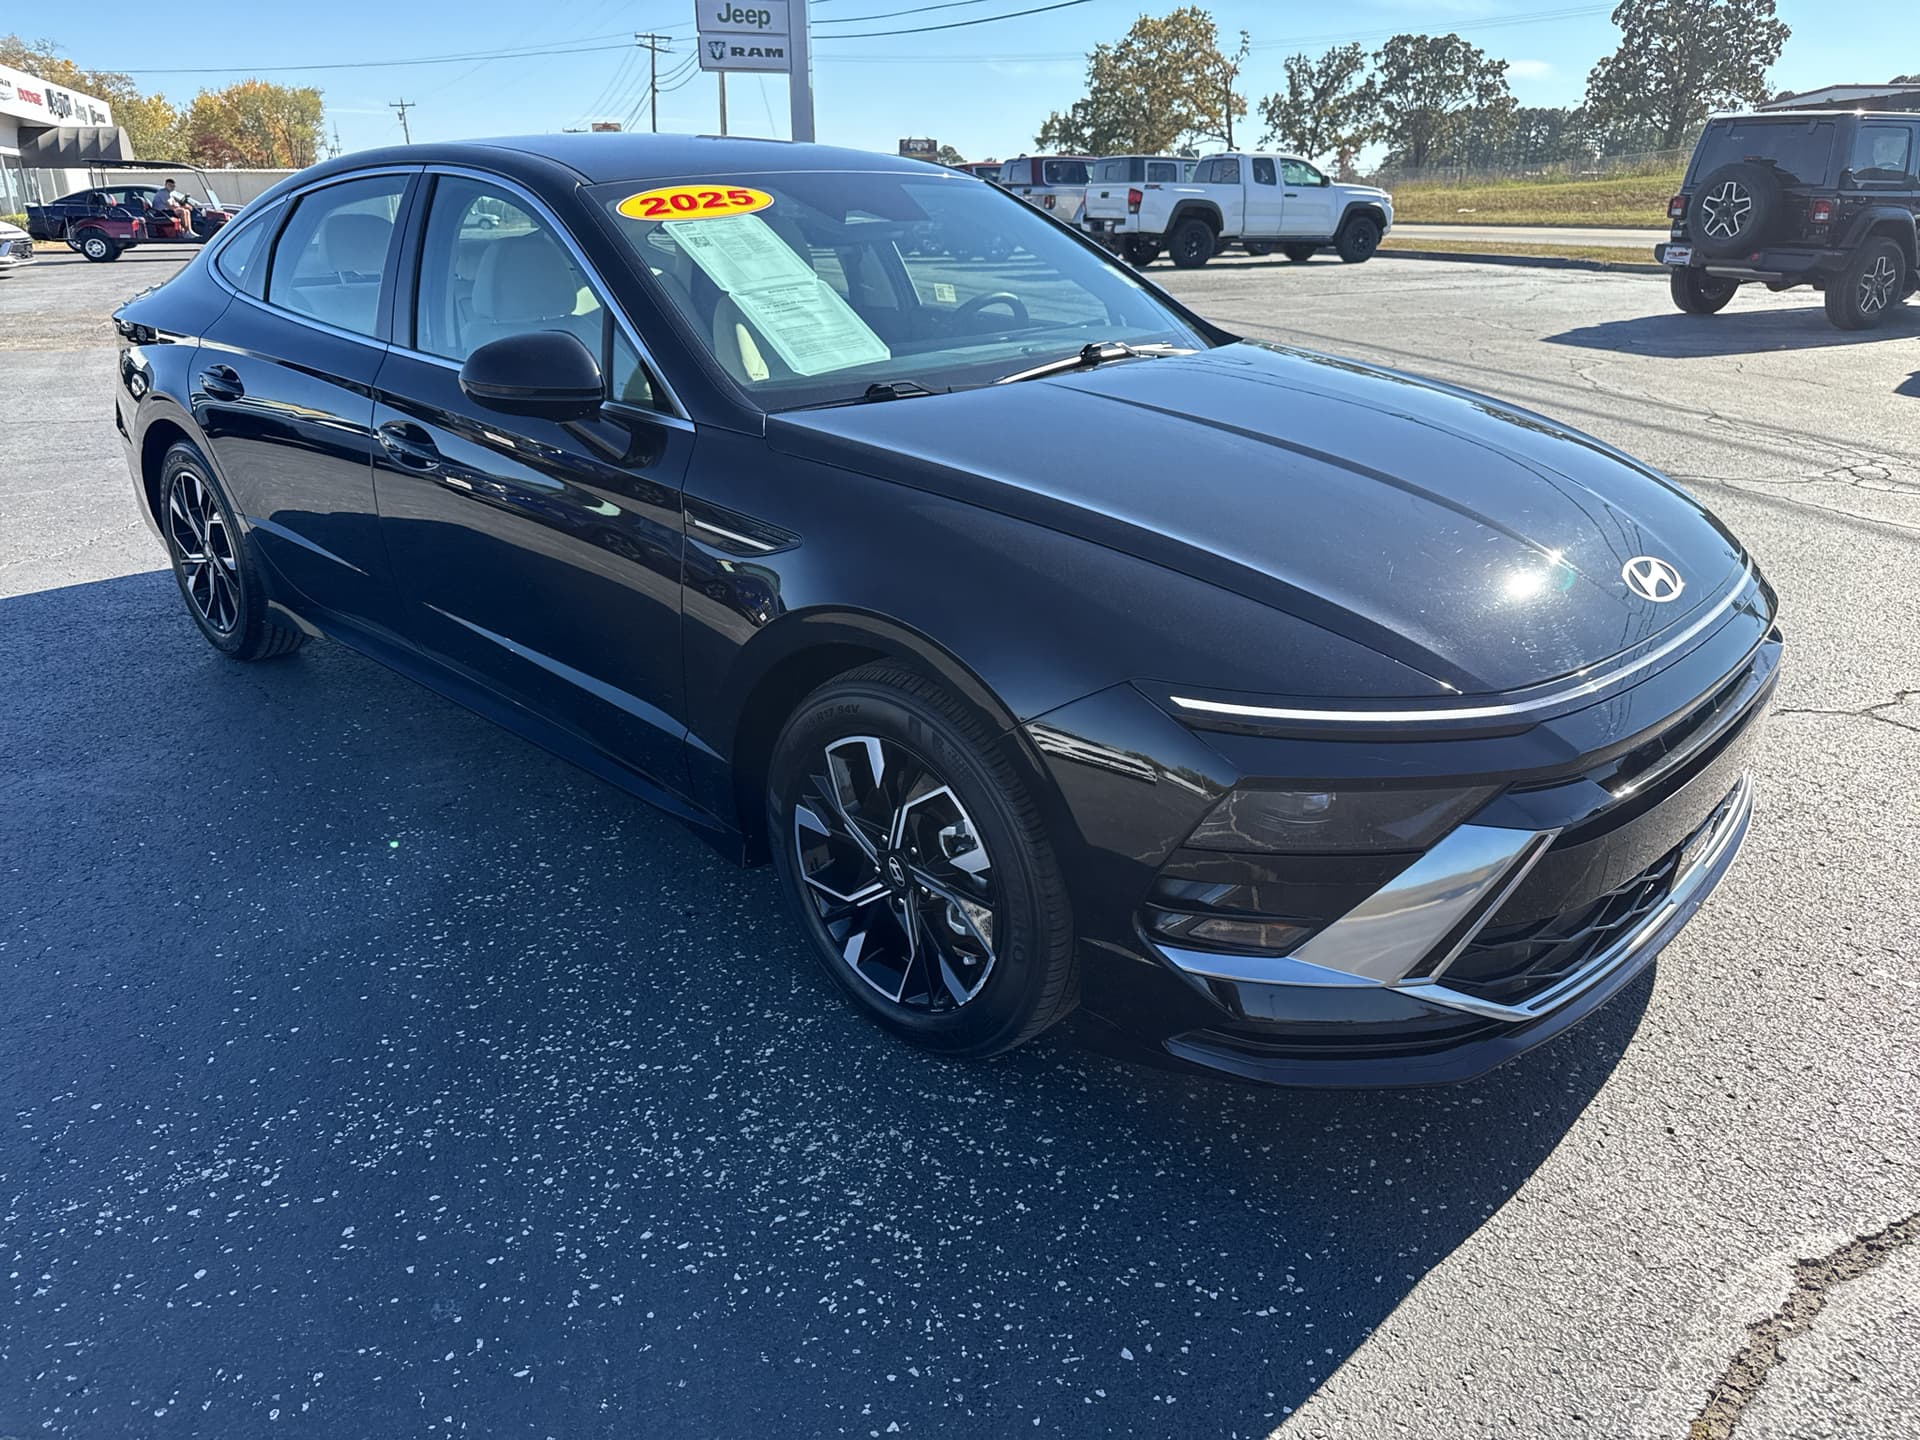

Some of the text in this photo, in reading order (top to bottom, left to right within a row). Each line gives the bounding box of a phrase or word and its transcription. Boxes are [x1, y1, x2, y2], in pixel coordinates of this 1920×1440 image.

[717, 3, 771, 29] Jeep
[730, 47, 784, 58] RAM
[639, 190, 755, 217] 2025
